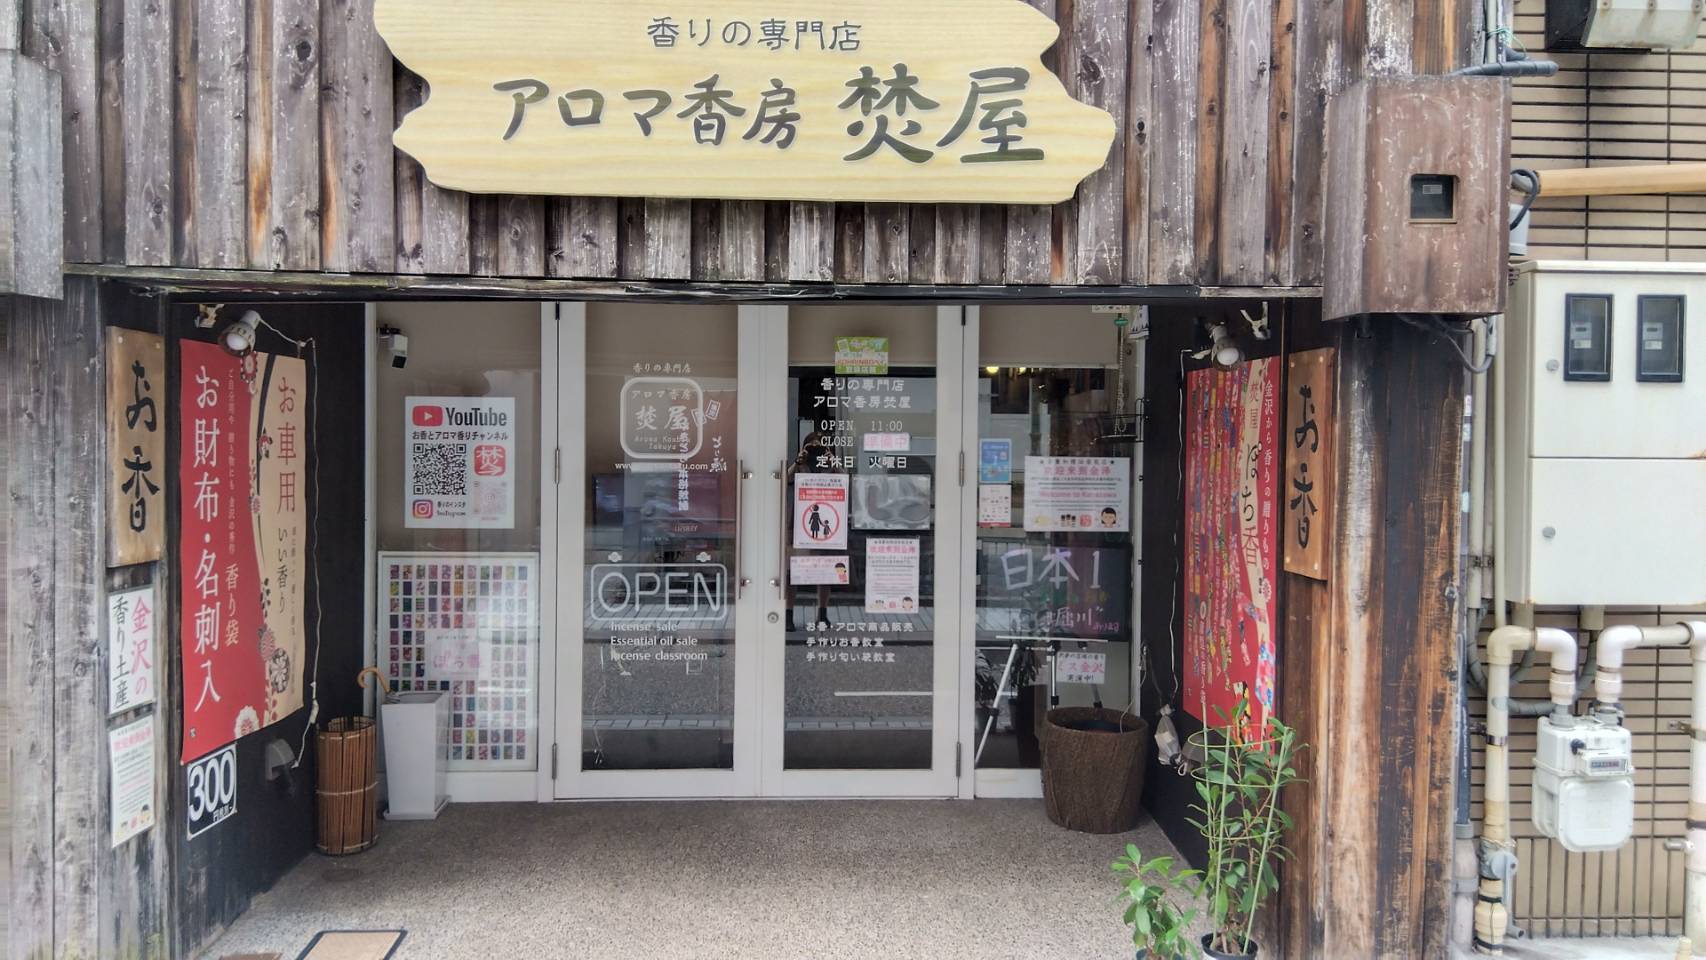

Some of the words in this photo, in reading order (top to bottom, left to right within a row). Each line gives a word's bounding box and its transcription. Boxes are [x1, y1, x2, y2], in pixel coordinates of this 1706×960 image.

[646, 17, 862, 51] 香りの専門店
[493, 74, 801, 149] アロマ香房
[837, 62, 1045, 164] 焚屋
[632, 362, 692, 373] 香りの専門店
[820, 378, 905, 391] 香りの専門店
[813, 396, 911, 408] アロマ香房焚屋
[445, 407, 507, 426] YouTube
[635, 405, 689, 430] 焚屋
[821, 420, 854, 431] OPEN
[871, 421, 903, 432] 11:00
[121, 360, 160, 533] お香
[412, 430, 509, 441] お香とアロマ香りチャンネル
[820, 436, 854, 447] CLOSE
[816, 457, 854, 469] 定休日
[868, 457, 907, 469] 火曜日
[1290, 384, 1319, 550] お香
[598, 572, 720, 612] OPEN
[225, 563, 239, 647] 香り袋
[131, 596, 152, 695] 金沢の
[610, 636, 657, 646] Essential
[660, 636, 673, 646] oil
[676, 636, 698, 646] sale
[112, 596, 131, 709] 香り土産
[655, 650, 708, 661] classroom
[190, 751, 234, 821] 300
